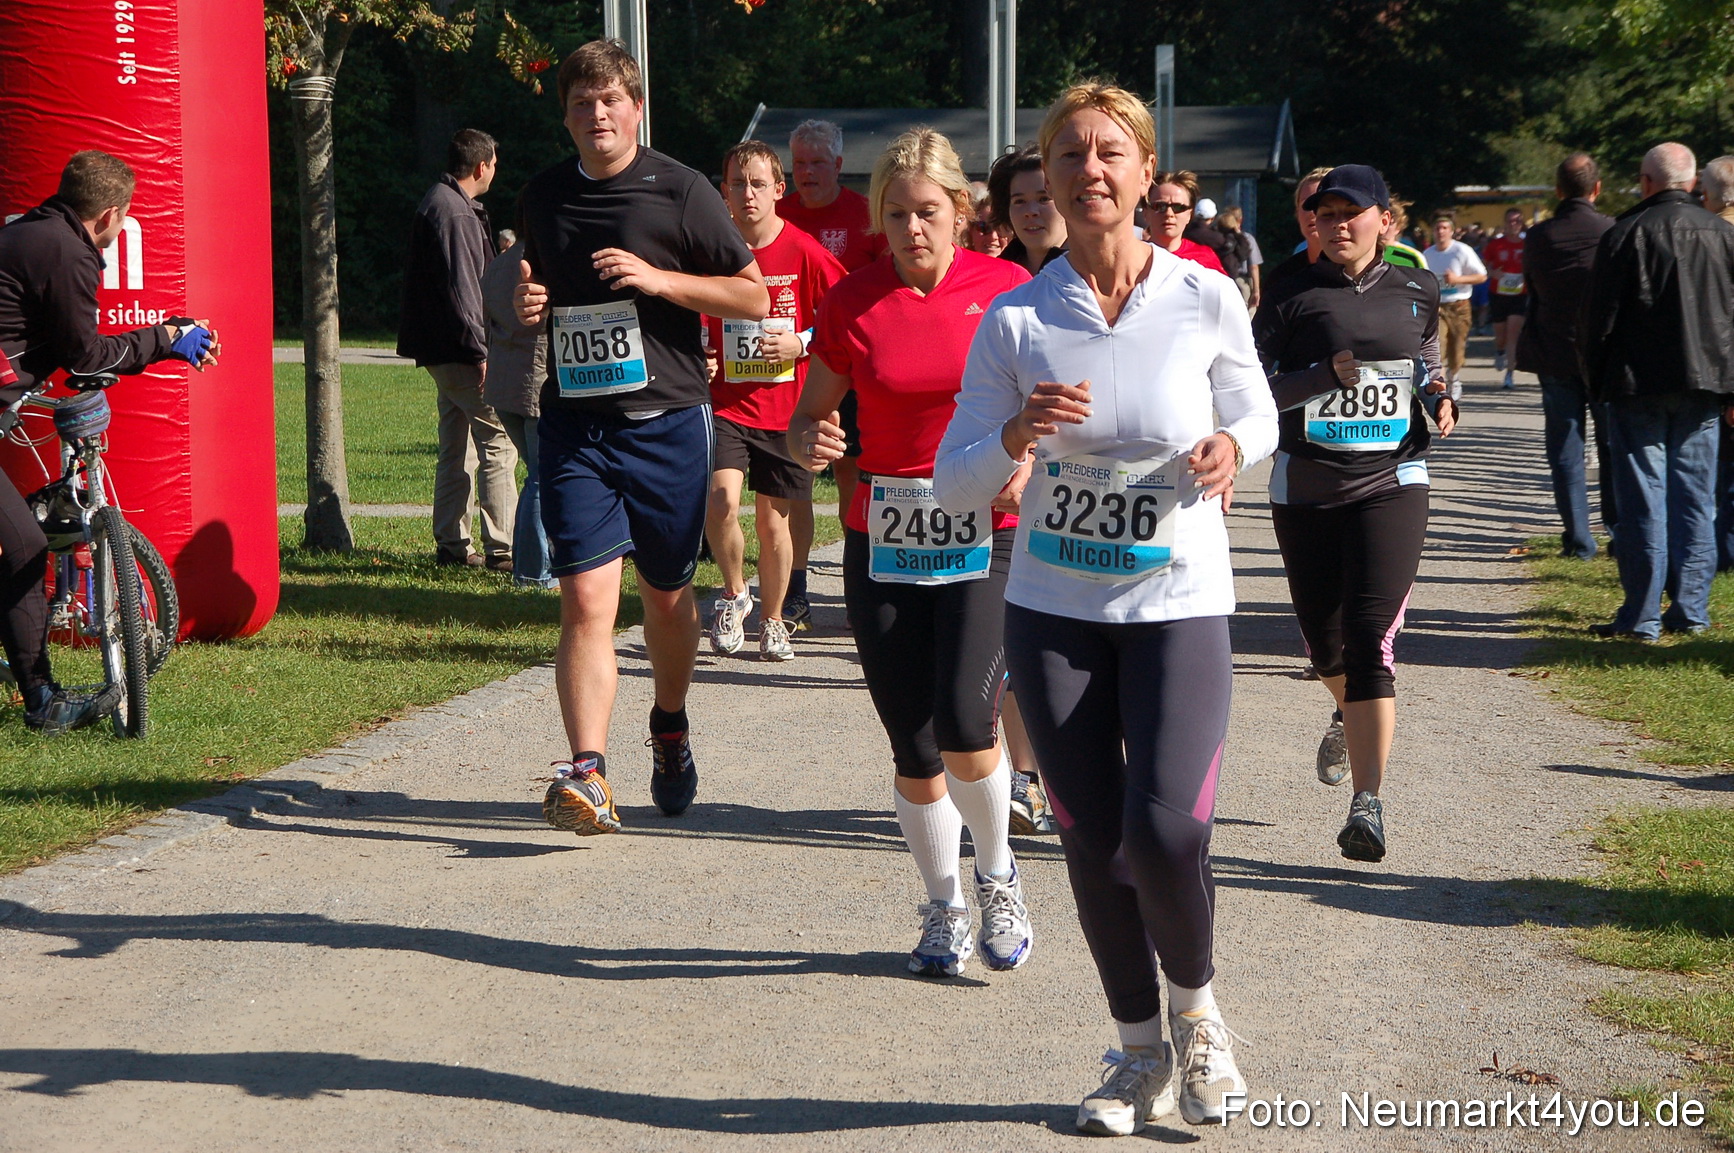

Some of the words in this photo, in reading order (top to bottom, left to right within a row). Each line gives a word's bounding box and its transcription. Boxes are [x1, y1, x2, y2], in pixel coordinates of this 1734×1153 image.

[114, 0, 135, 44] 1929
[117, 51, 137, 85] Seit
[107, 300, 167, 325] sicher
[560, 326, 631, 364] 2058
[568, 363, 626, 385] Konrad
[735, 361, 784, 374] Damian
[1318, 384, 1398, 418] 2893
[1325, 421, 1391, 439] Simone
[1061, 461, 1111, 481] PFLEIDERER
[881, 506, 977, 546] 2493
[1044, 484, 1158, 542] 3236
[895, 548, 966, 571] Sandra
[1059, 537, 1137, 571] Nicole
